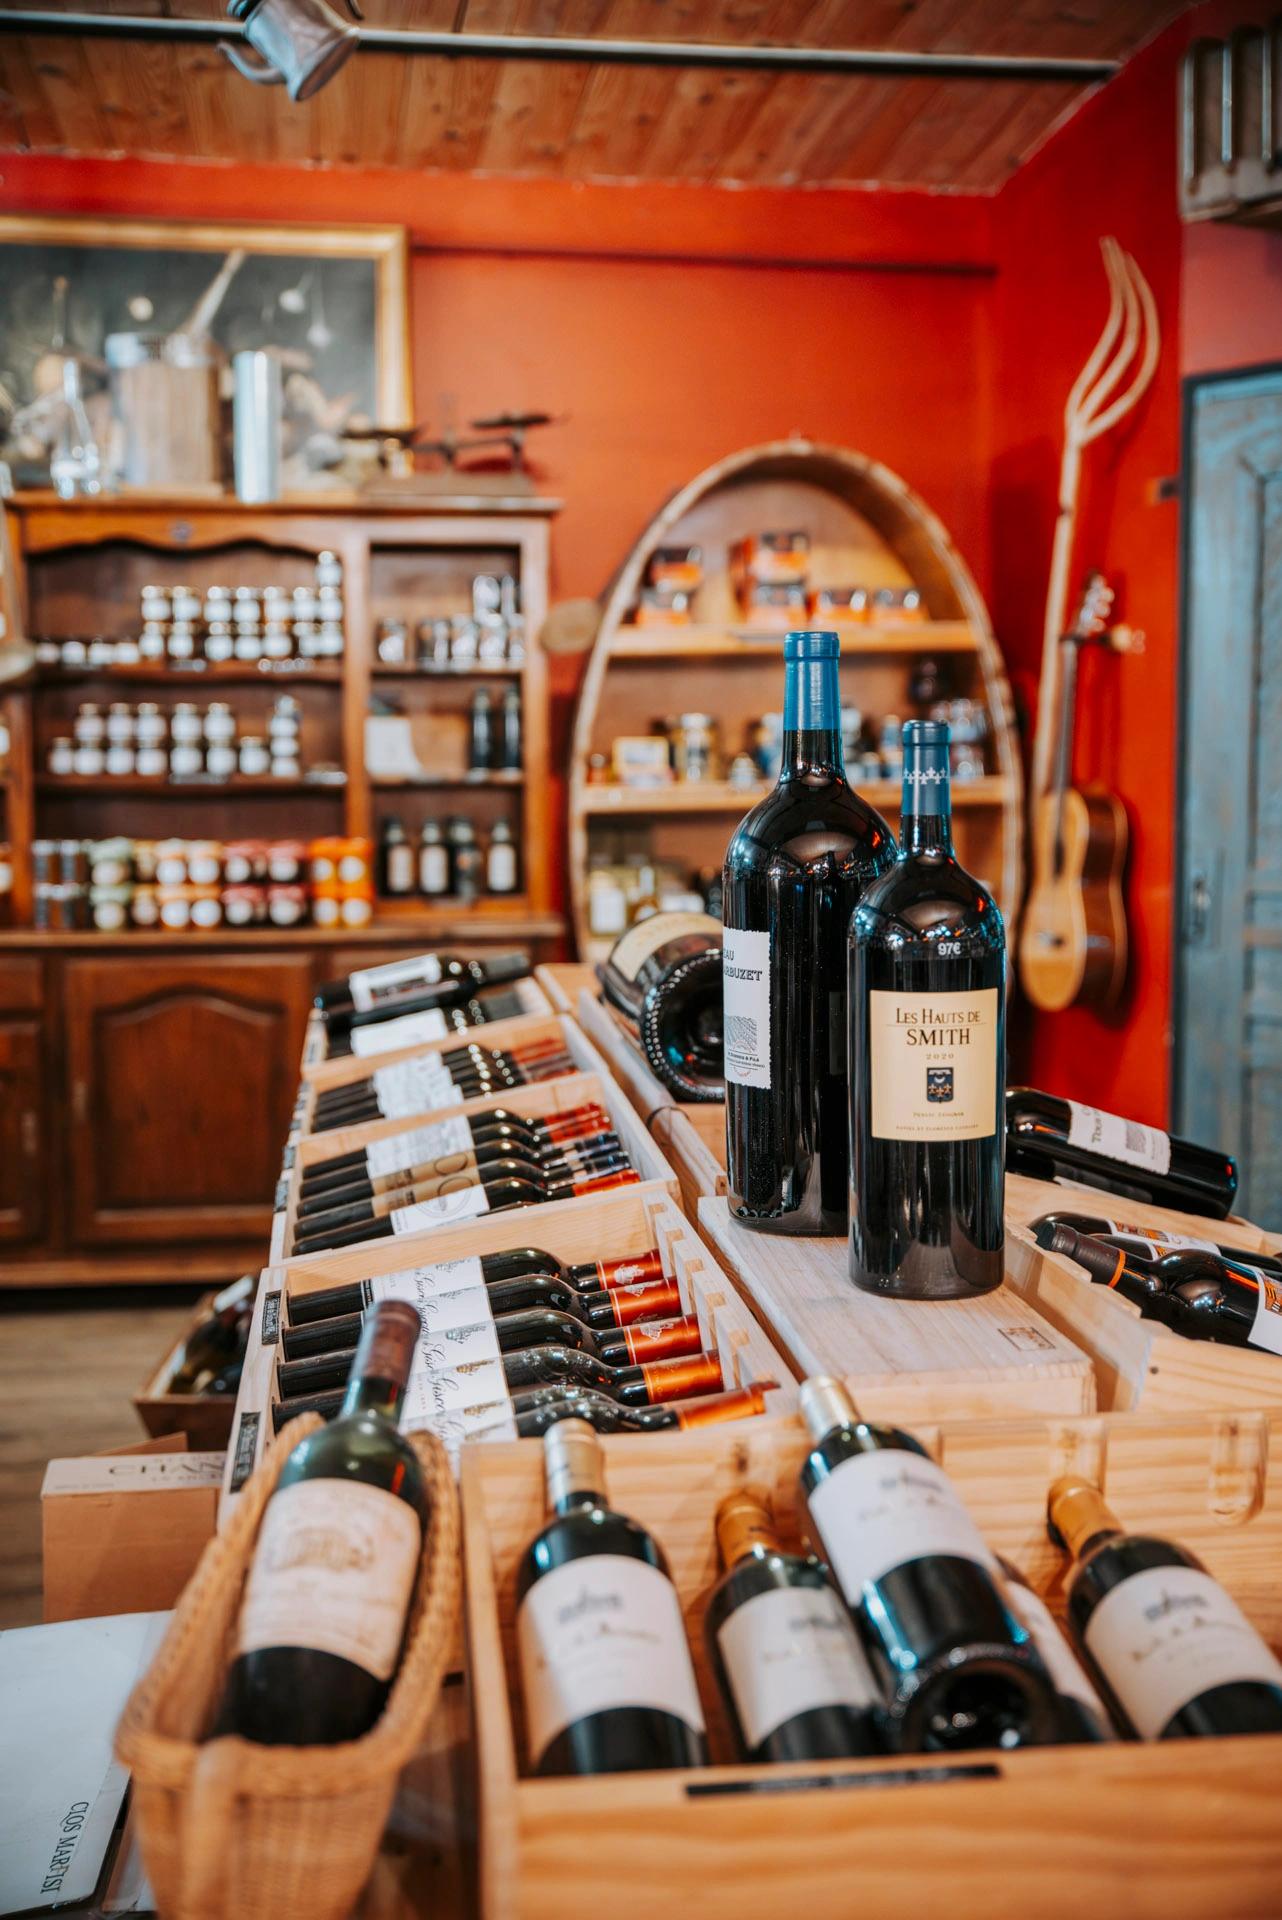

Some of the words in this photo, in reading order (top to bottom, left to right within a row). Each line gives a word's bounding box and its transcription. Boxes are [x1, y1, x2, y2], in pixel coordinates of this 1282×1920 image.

[937, 942, 961, 956] 97€
[906, 1028, 971, 1046] SMITH
[60, 1801, 89, 1833] CLOS
